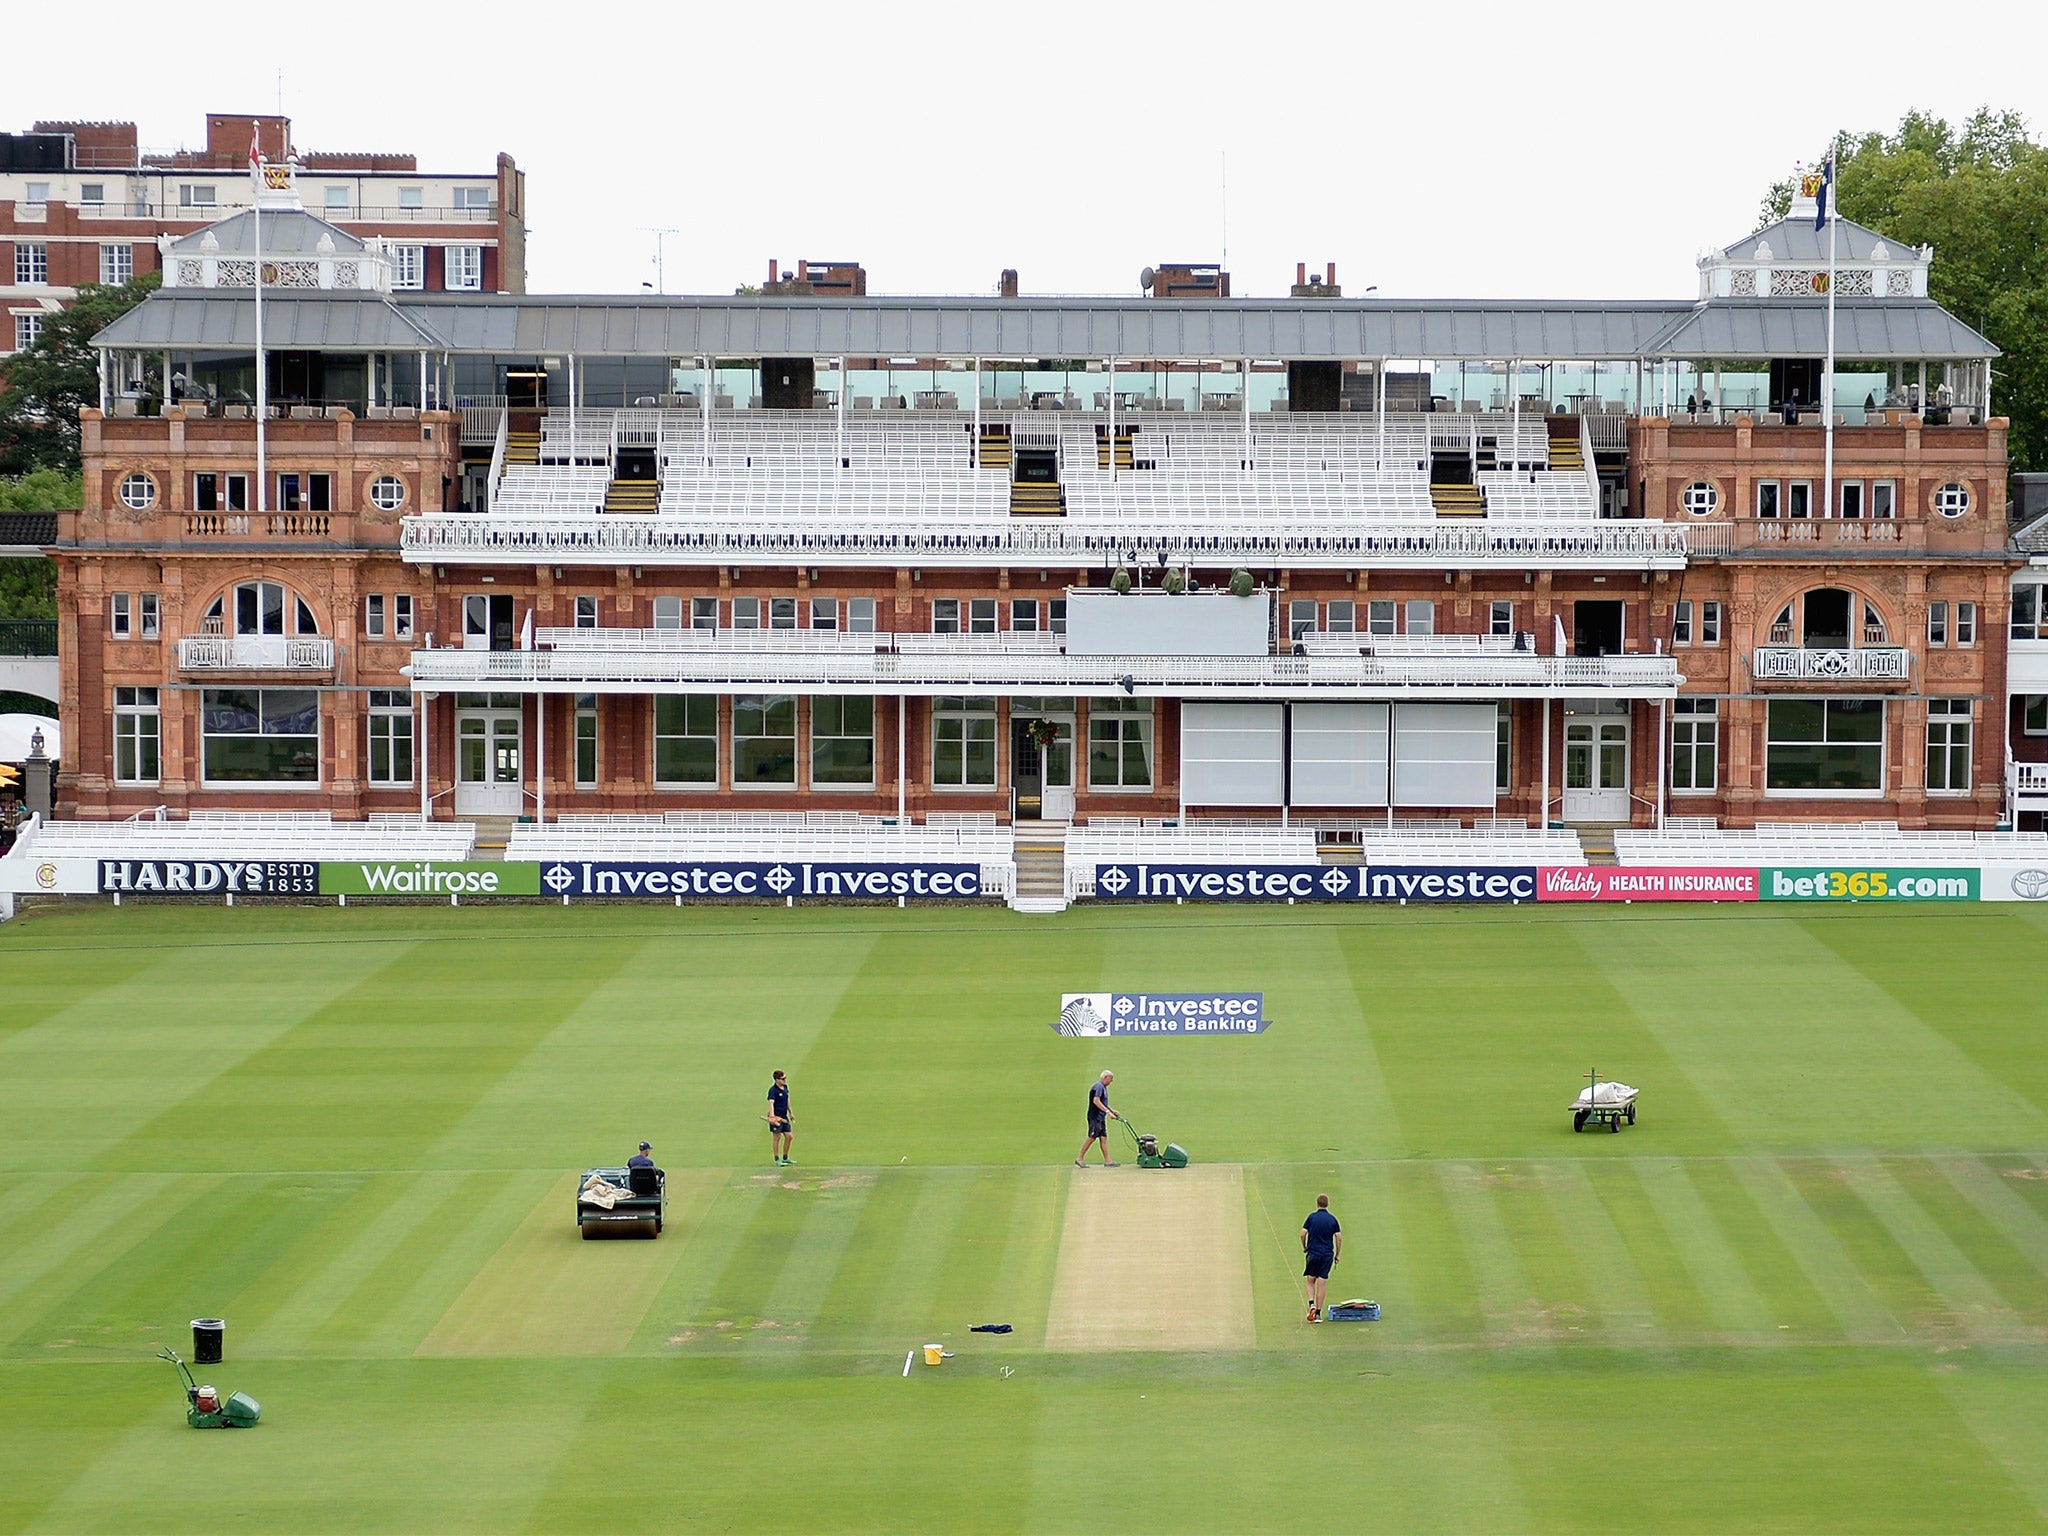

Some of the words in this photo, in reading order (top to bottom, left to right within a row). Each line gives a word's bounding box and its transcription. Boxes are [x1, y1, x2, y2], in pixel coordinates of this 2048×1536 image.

[103, 862, 264, 891] HARDYS
[267, 863, 314, 877] ESTD
[361, 862, 499, 892] Waitrose
[581, 863, 757, 894] Investec
[802, 864, 977, 895] Investec
[1137, 865, 1313, 896] Investec
[1357, 866, 1533, 898] Investec
[1546, 867, 1603, 899] Vitality
[1609, 875, 1665, 891] HEALTH
[1669, 875, 1753, 892] INSURANCE
[1772, 870, 1968, 897] bet365.com
[267, 879, 314, 892] 1853
[1138, 995, 1258, 1017] Investec
[1114, 1017, 1177, 1032] Private
[1185, 1017, 1257, 1033] Banking
